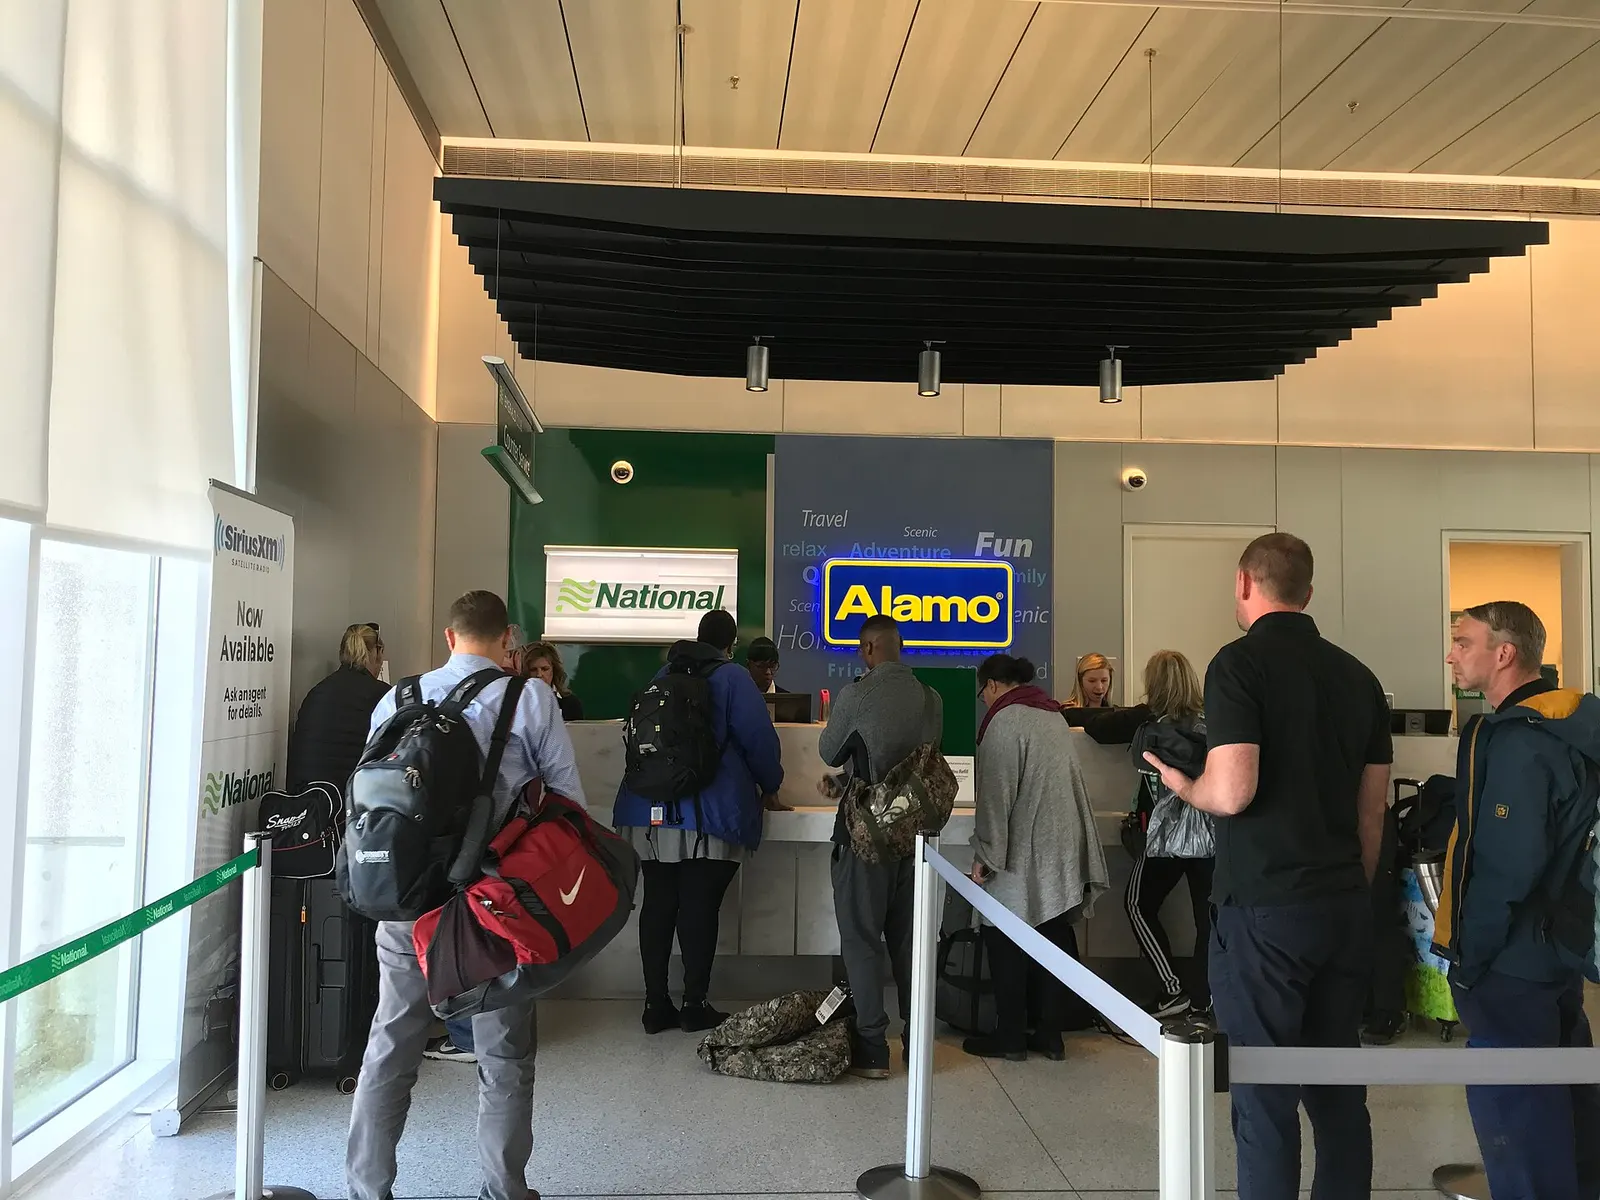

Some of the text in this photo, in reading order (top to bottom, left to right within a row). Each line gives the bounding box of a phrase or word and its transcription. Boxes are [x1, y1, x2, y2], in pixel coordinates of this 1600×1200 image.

[802, 509, 848, 528] Travel
[904, 526, 938, 538] Scenic
[782, 541, 827, 557] relax
[850, 541, 951, 559] Adventure
[974, 531, 1033, 557] Fun
[1015, 568, 1047, 587] mily
[595, 583, 725, 610] National
[789, 598, 820, 612] Scen
[835, 584, 1001, 624] Alamo
[237, 600, 264, 628] Now
[1014, 605, 1049, 624] enic
[220, 635, 274, 662] Available
[223, 686, 237, 702] Ask
[248, 686, 267, 703] agent
[228, 705, 238, 720] for
[221, 762, 276, 808] National
[221, 864, 237, 880] National
[152, 899, 174, 921] National
[61, 943, 89, 967] National
